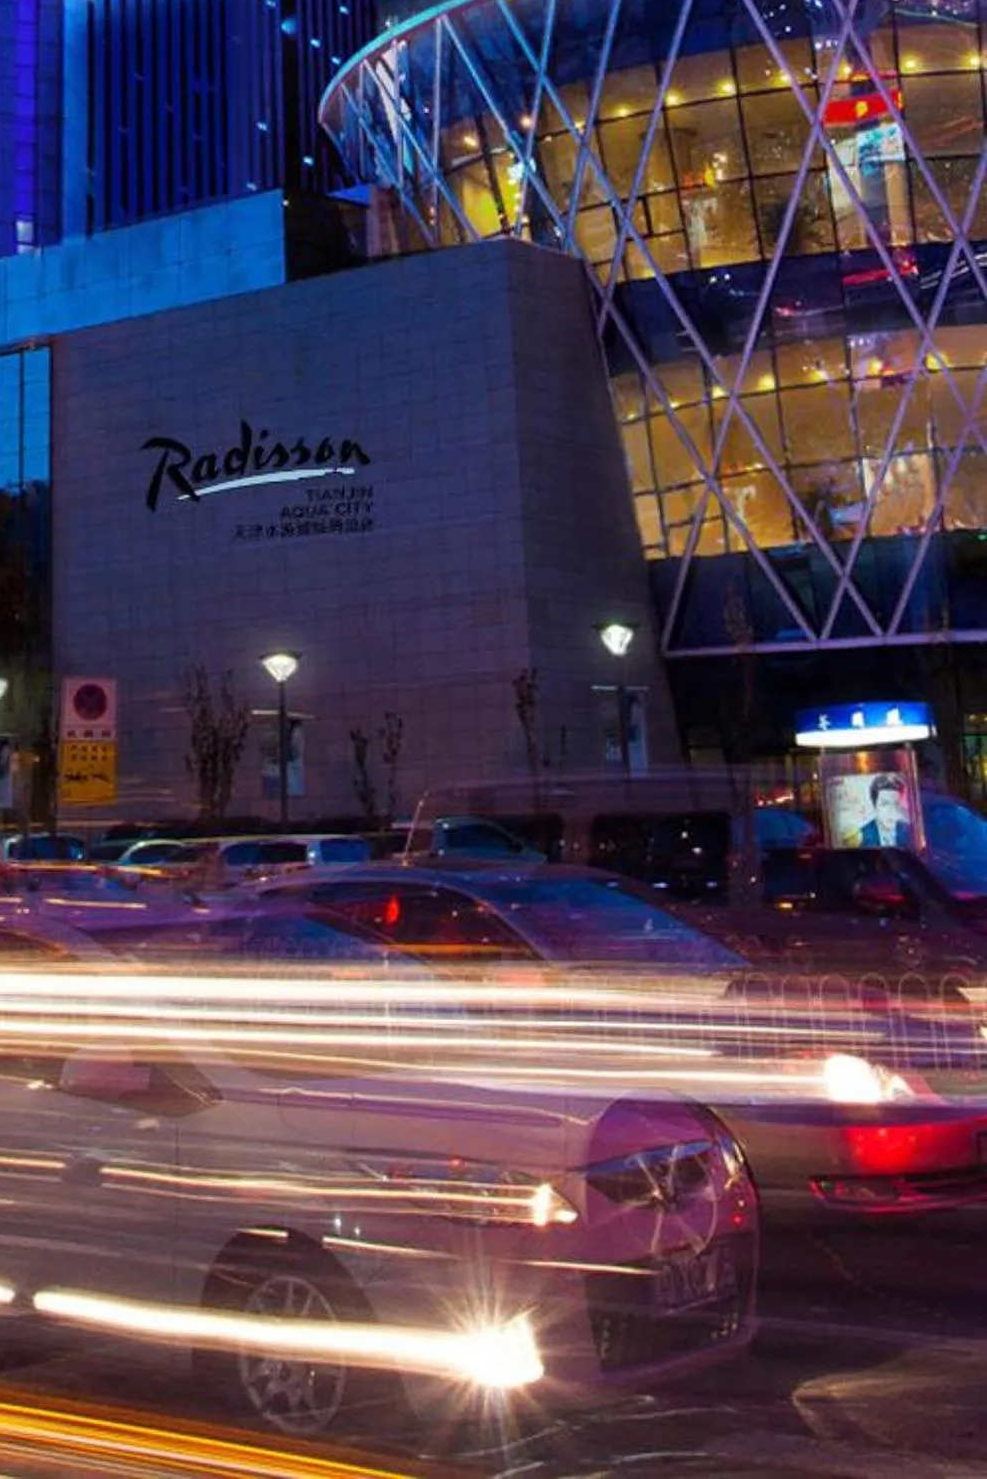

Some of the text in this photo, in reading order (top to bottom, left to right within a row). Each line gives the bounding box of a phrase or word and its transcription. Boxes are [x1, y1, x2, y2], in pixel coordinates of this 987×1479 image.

[140, 419, 371, 513] Radisson
[306, 484, 374, 503] TIANJIN
[280, 501, 374, 519] AQUA CITY
